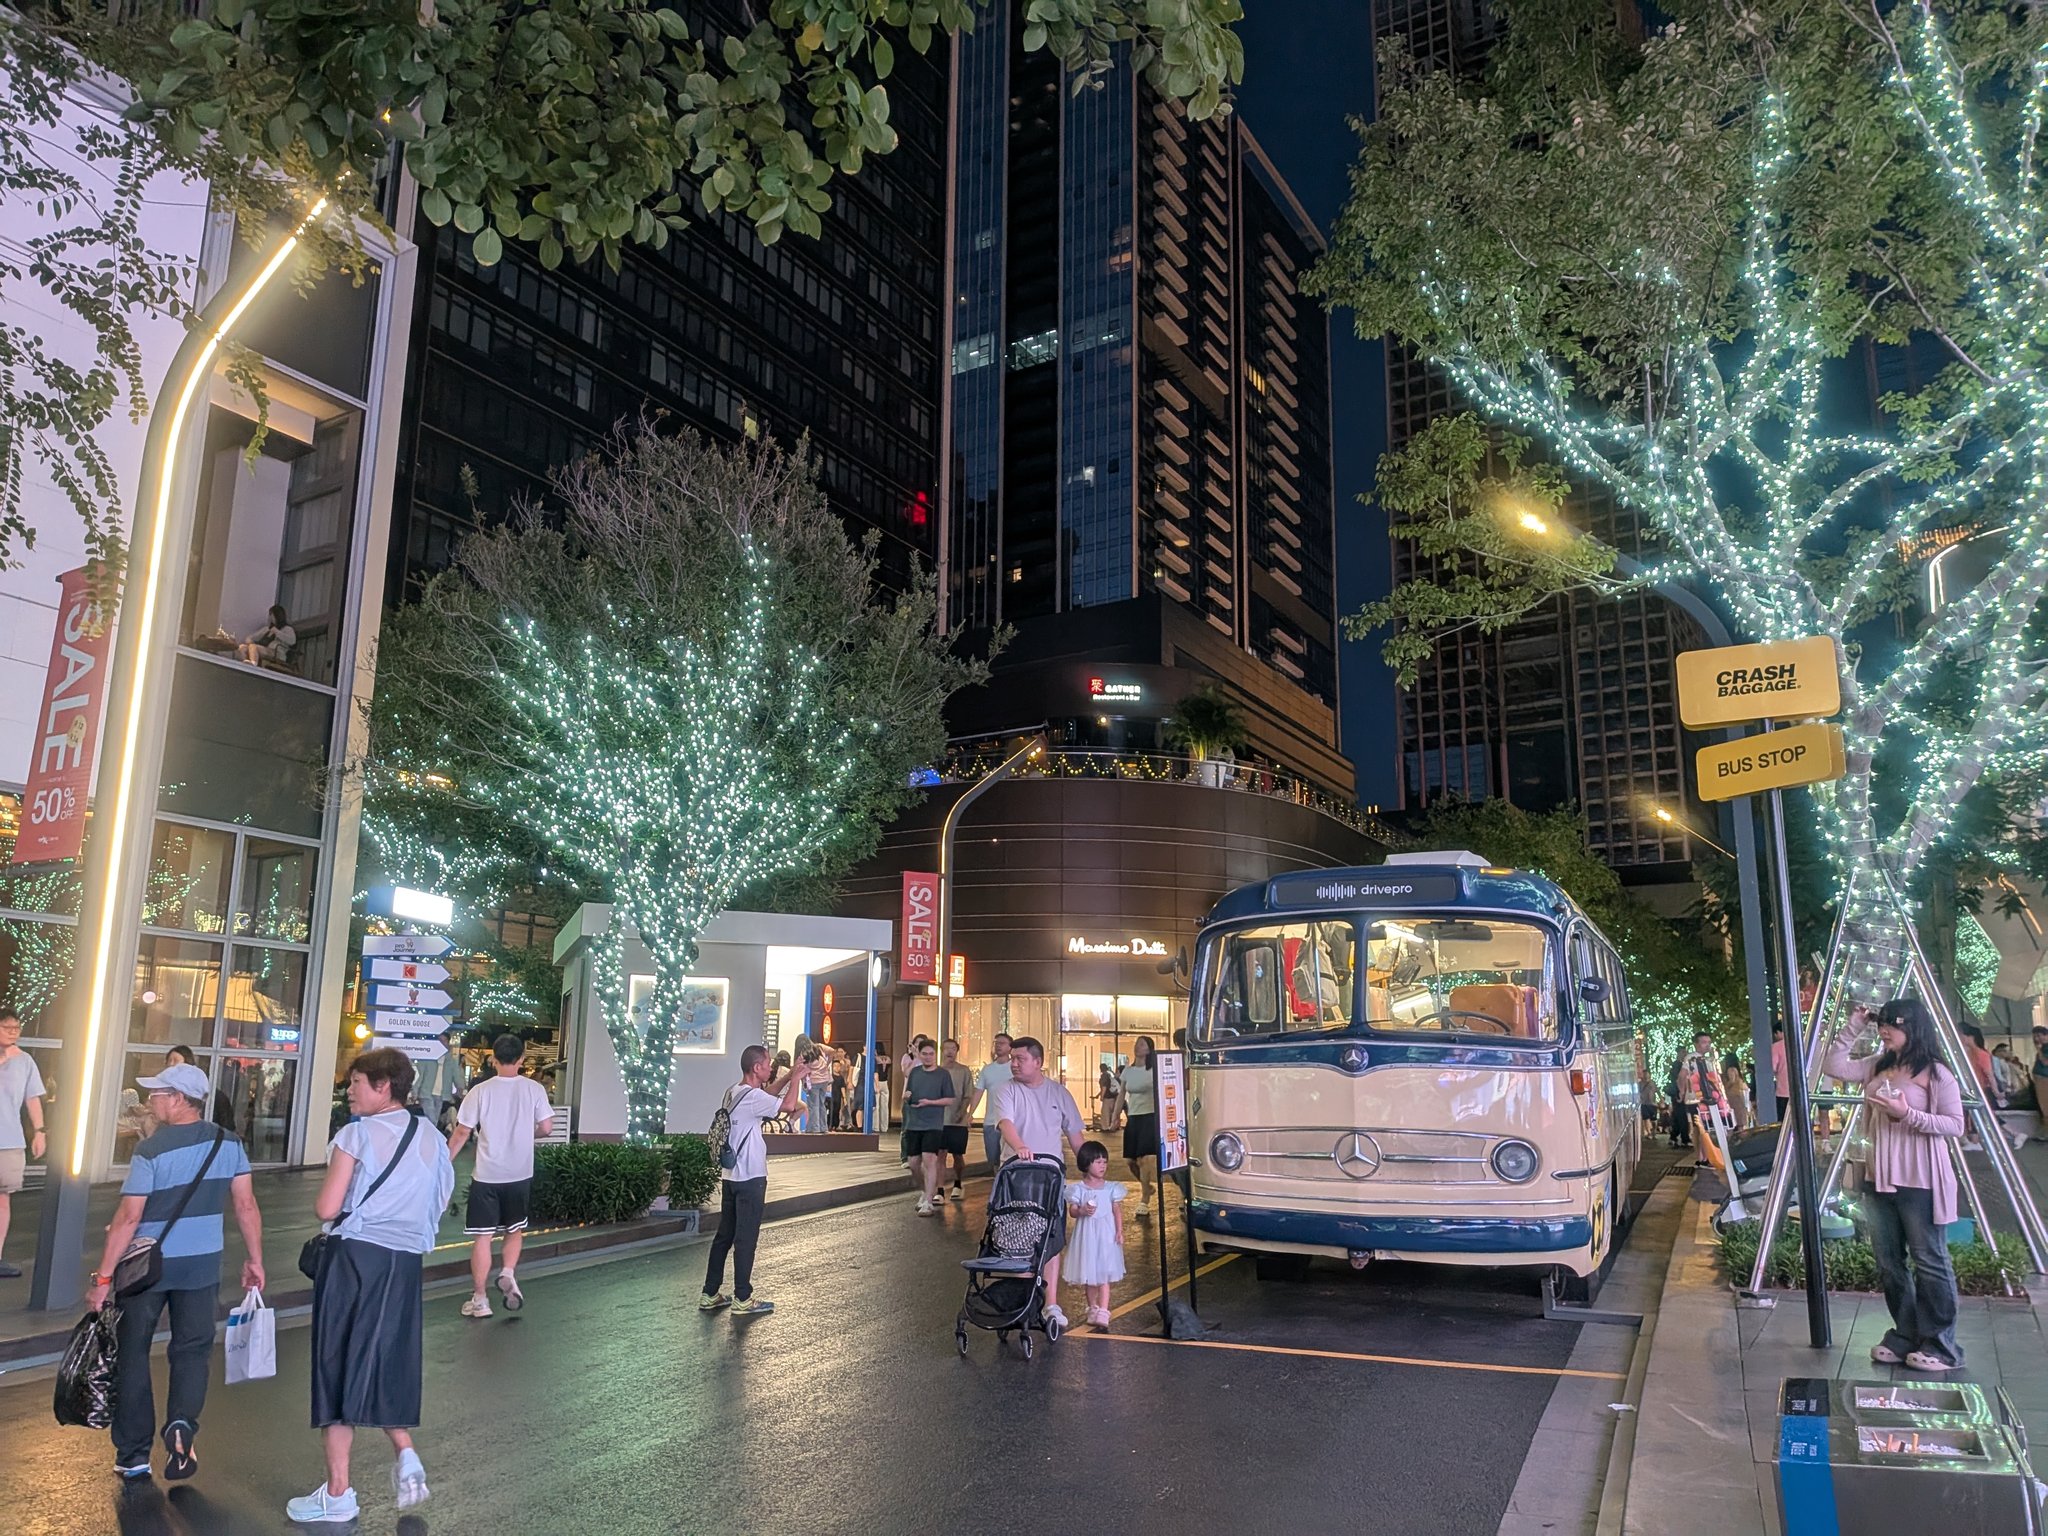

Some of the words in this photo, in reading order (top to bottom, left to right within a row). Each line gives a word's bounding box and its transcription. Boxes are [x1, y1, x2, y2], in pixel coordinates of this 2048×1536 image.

[1716, 663, 1796, 686] CRASH
[40, 600, 103, 774] SALE
[1104, 684, 1141, 693] GATHER
[1718, 757, 1753, 778] BUS
[1758, 745, 1807, 768] STOP
[60, 810, 74, 821] OFF
[1361, 884, 1413, 896] drivepro
[908, 886, 933, 949] SALE
[1068, 937, 1130, 954] Massimo
[1131, 938, 1168, 955] Dutti
[388, 1018, 411, 1026] GOLDEN
[413, 1020, 431, 1028] GOOSE
